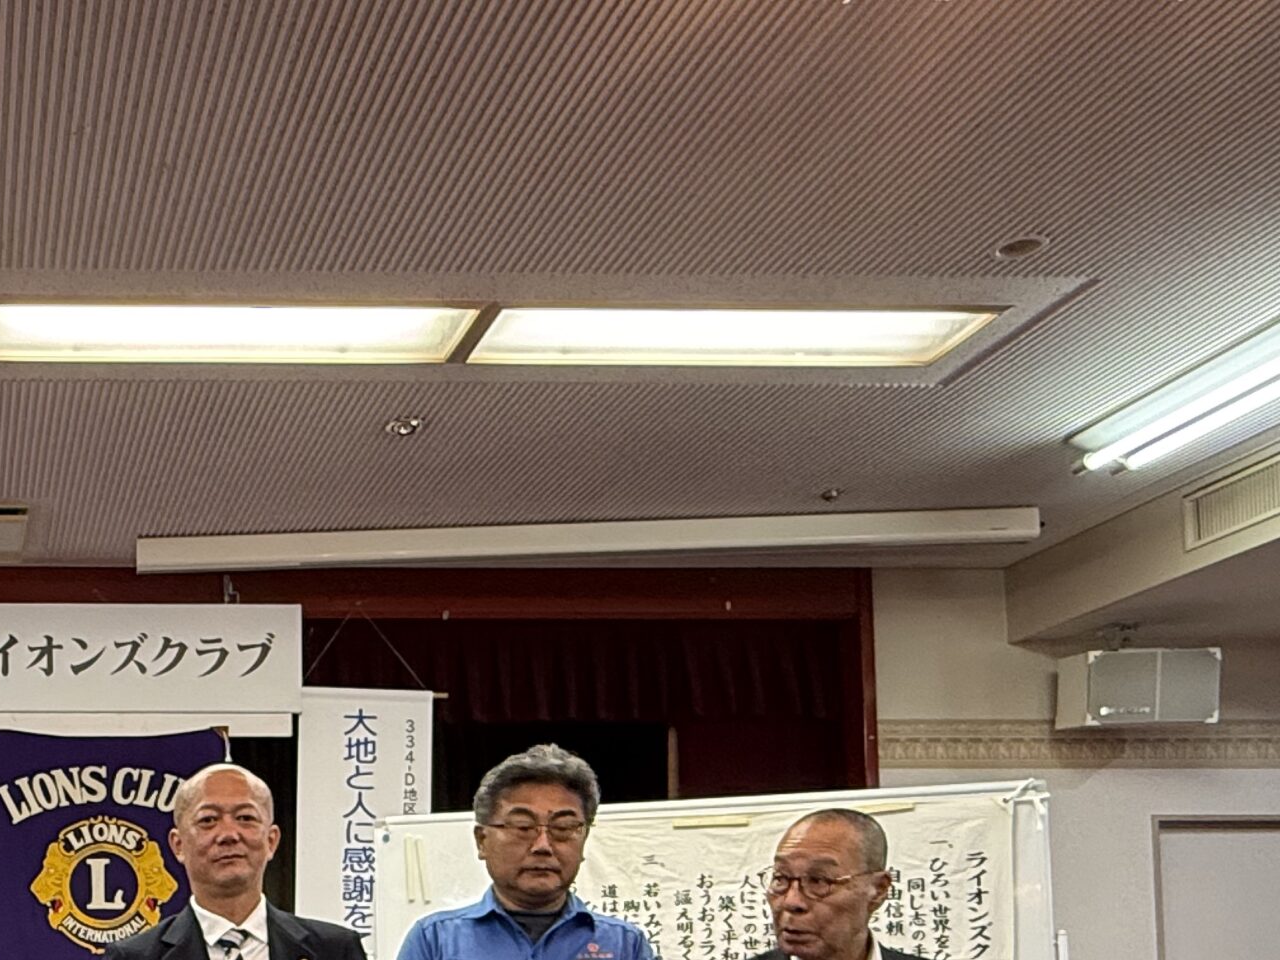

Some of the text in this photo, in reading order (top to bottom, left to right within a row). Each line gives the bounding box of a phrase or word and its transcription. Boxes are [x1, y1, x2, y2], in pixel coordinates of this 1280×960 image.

[66, 823, 141, 850] LIONS
[342, 709, 377, 938] 大地と人に感謝を
[86, 858, 126, 910] L
[62, 915, 147, 944] INTERNATIONAL
